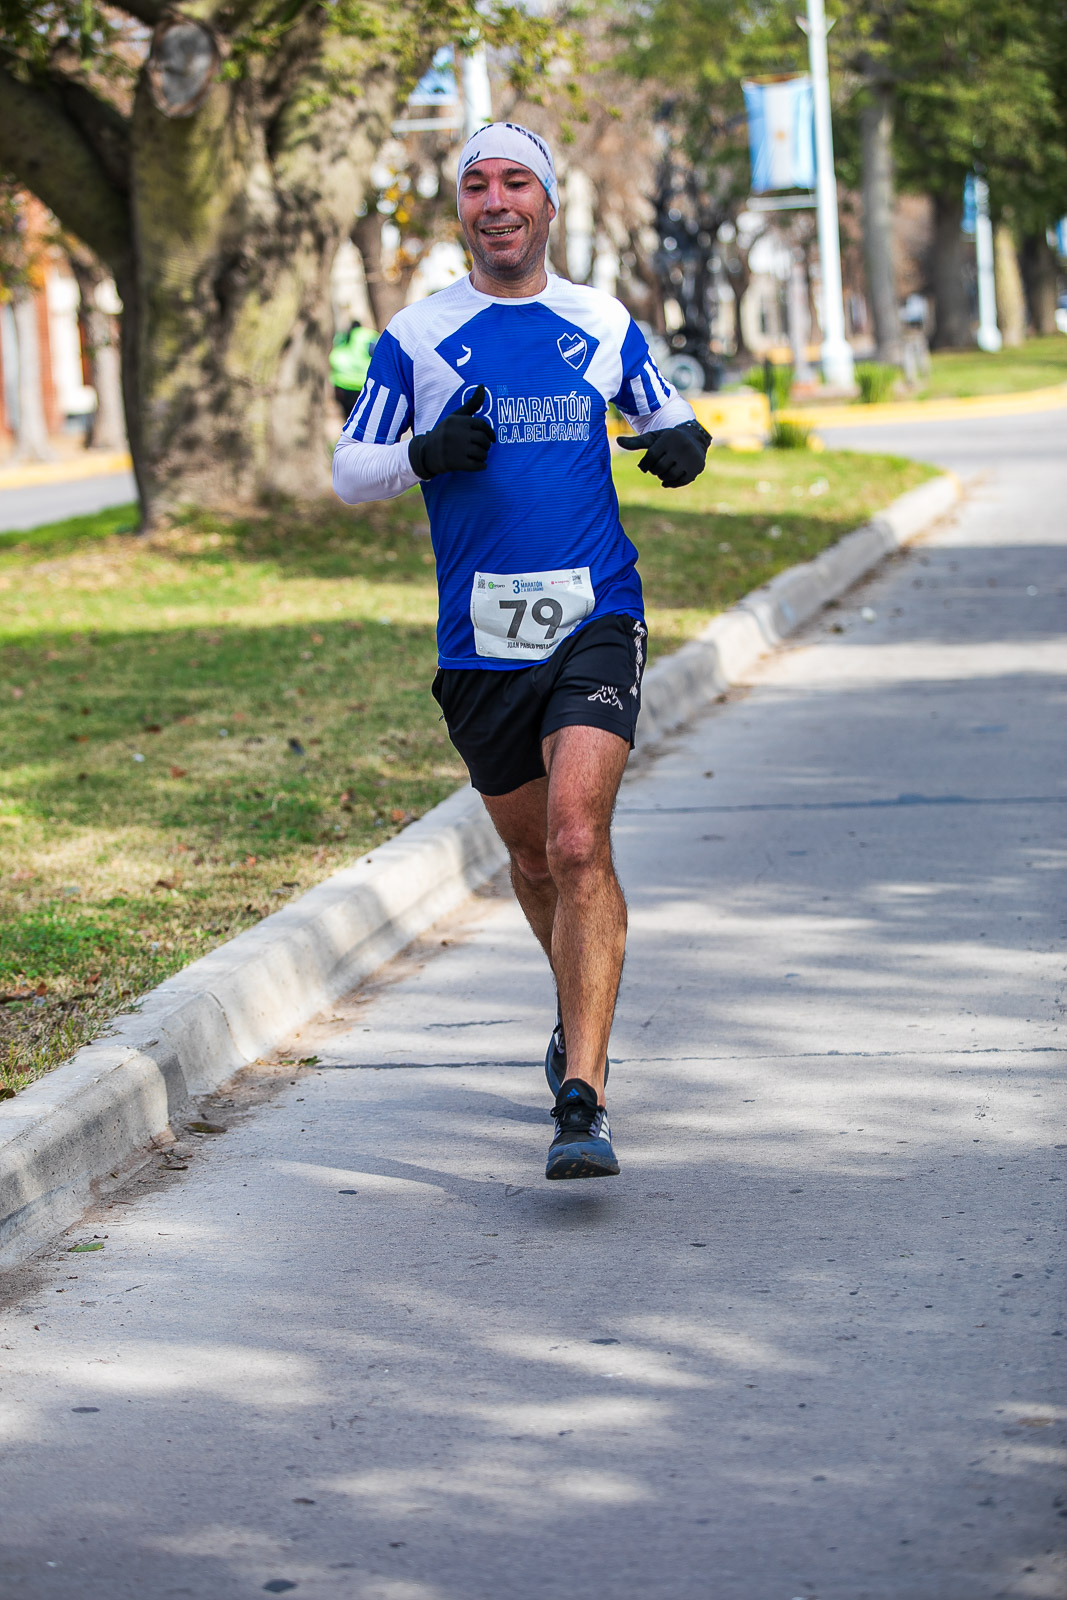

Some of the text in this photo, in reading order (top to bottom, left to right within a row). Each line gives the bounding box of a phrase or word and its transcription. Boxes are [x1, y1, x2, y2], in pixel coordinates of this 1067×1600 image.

[497, 391, 592, 424] MARATÓN
[512, 579, 521, 594] 3
[520, 580, 543, 588] MARATÓN
[498, 597, 563, 640] 79
[507, 641, 520, 649] JUAN
